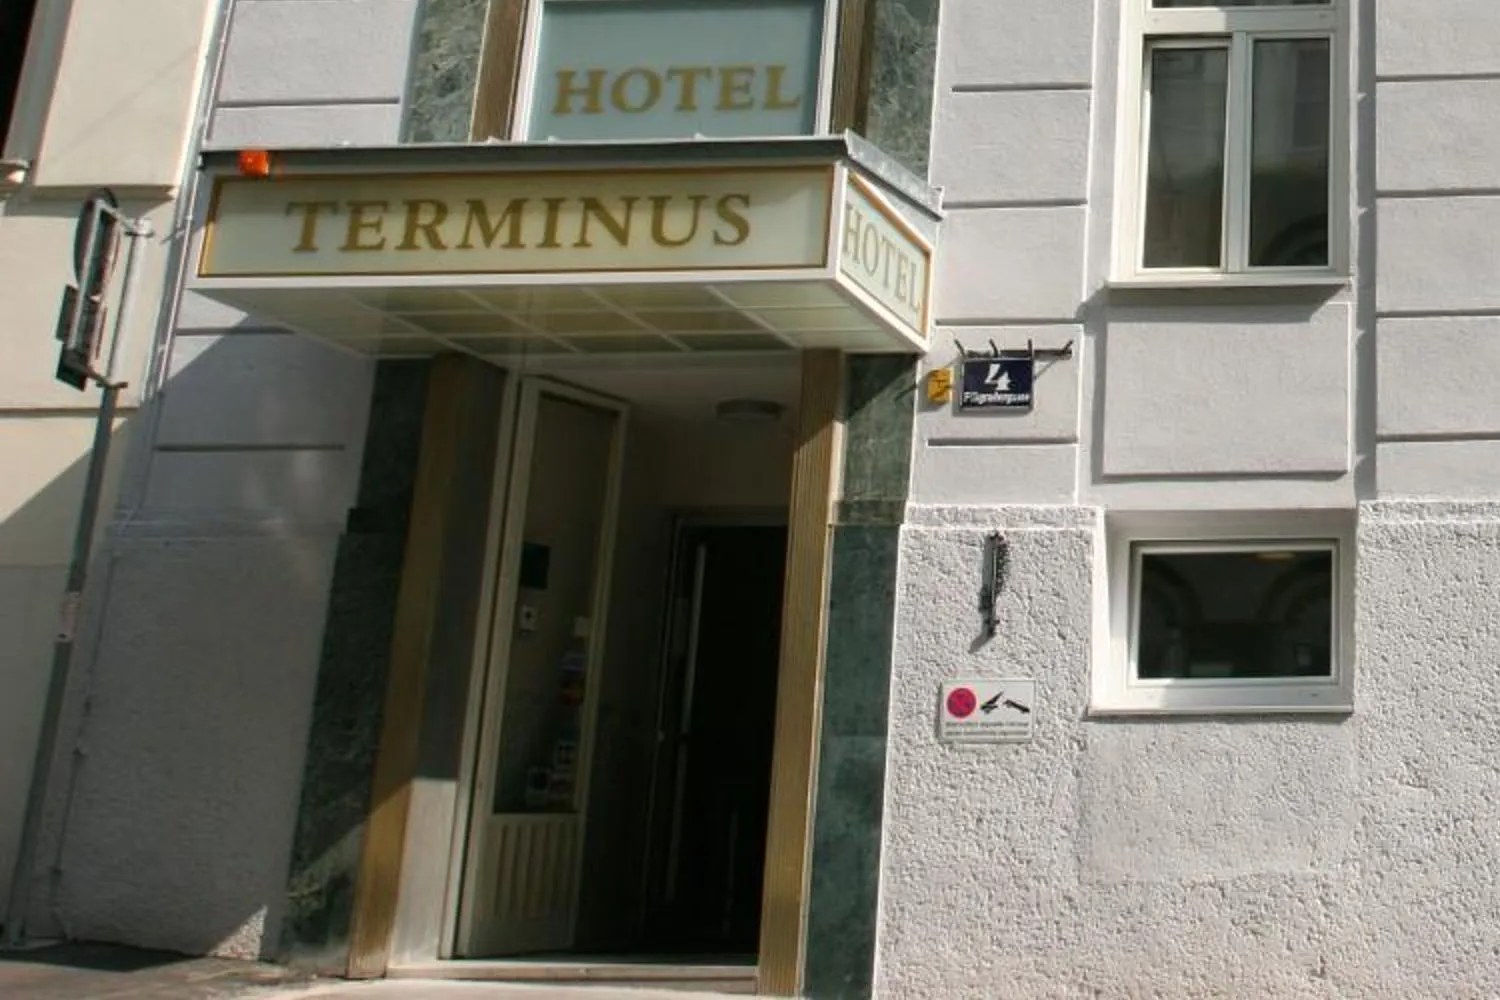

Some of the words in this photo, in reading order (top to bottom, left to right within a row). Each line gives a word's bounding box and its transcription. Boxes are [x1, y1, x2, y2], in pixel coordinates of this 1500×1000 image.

[550, 63, 803, 115] HOTEL
[285, 192, 752, 253] TERMINUS
[843, 202, 920, 313] HOTEL
[984, 363, 1012, 391] 4
